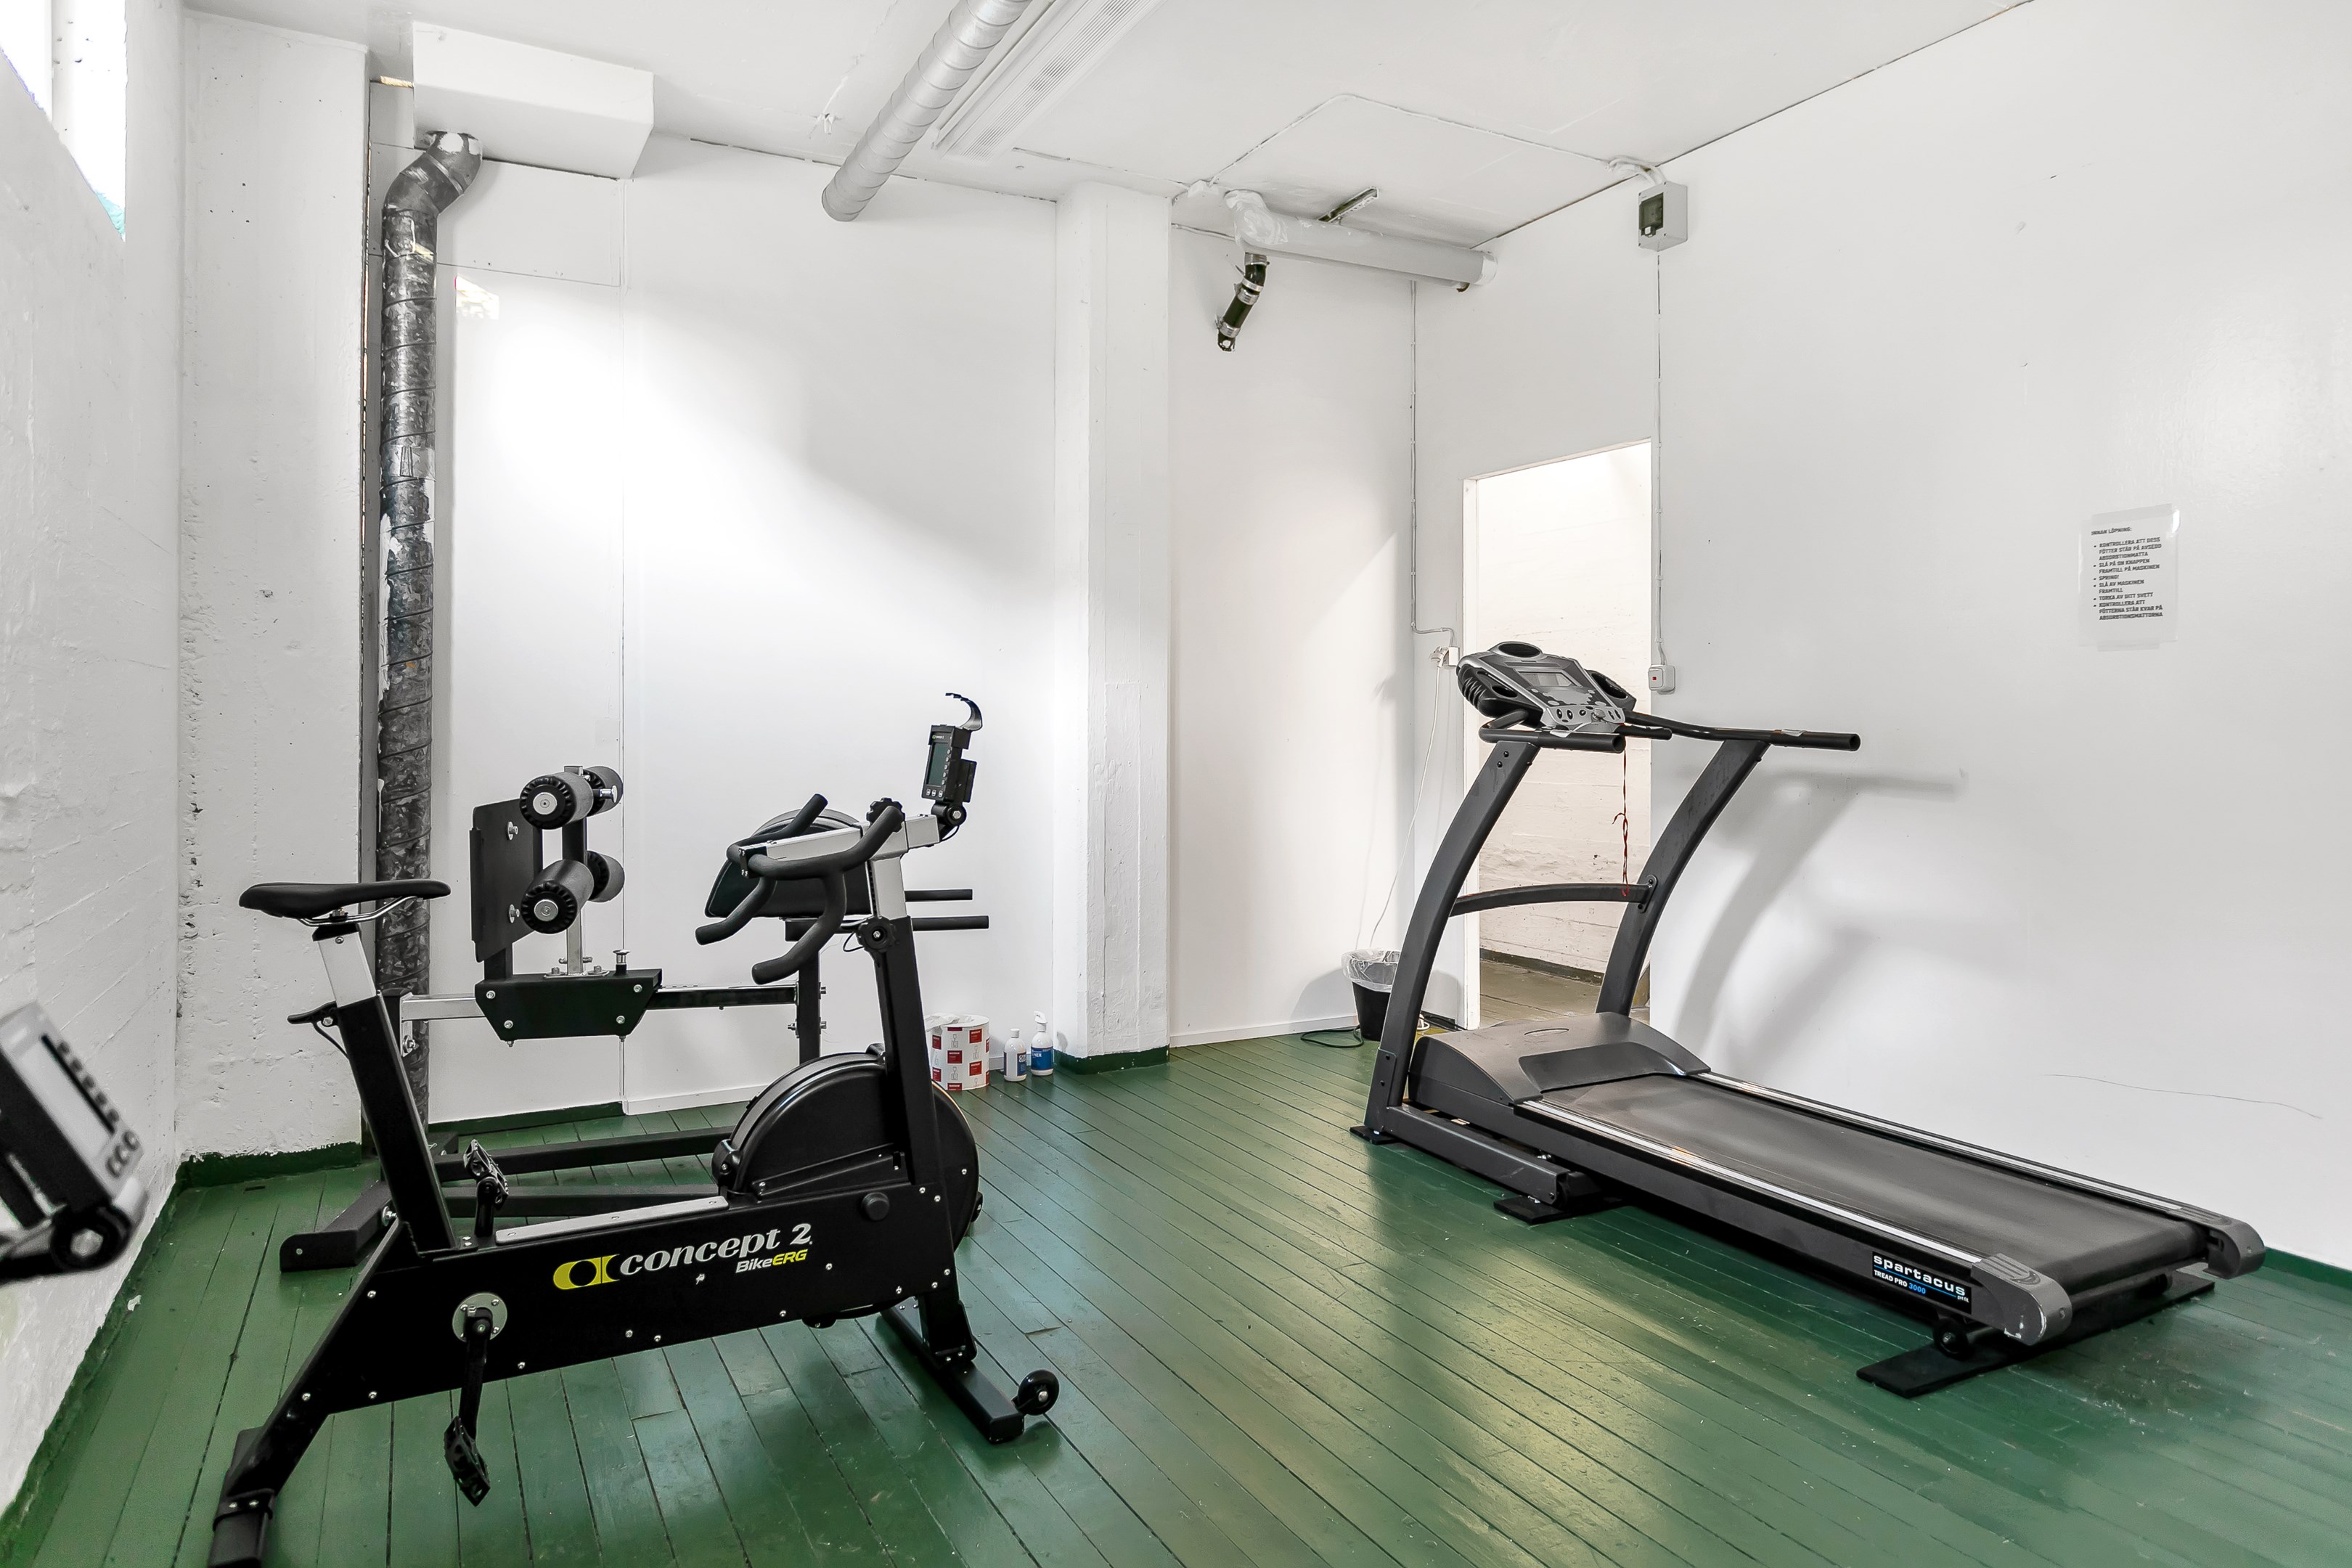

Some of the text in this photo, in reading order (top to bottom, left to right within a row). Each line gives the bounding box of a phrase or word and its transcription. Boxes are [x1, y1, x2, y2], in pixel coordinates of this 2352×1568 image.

[619, 1223, 811, 1275] concept 2
[735, 1249, 809, 1274] BikeERG
[1874, 1254, 1966, 1296] spartacus
[1874, 1270, 1927, 1294] TREAD PRO 3000
